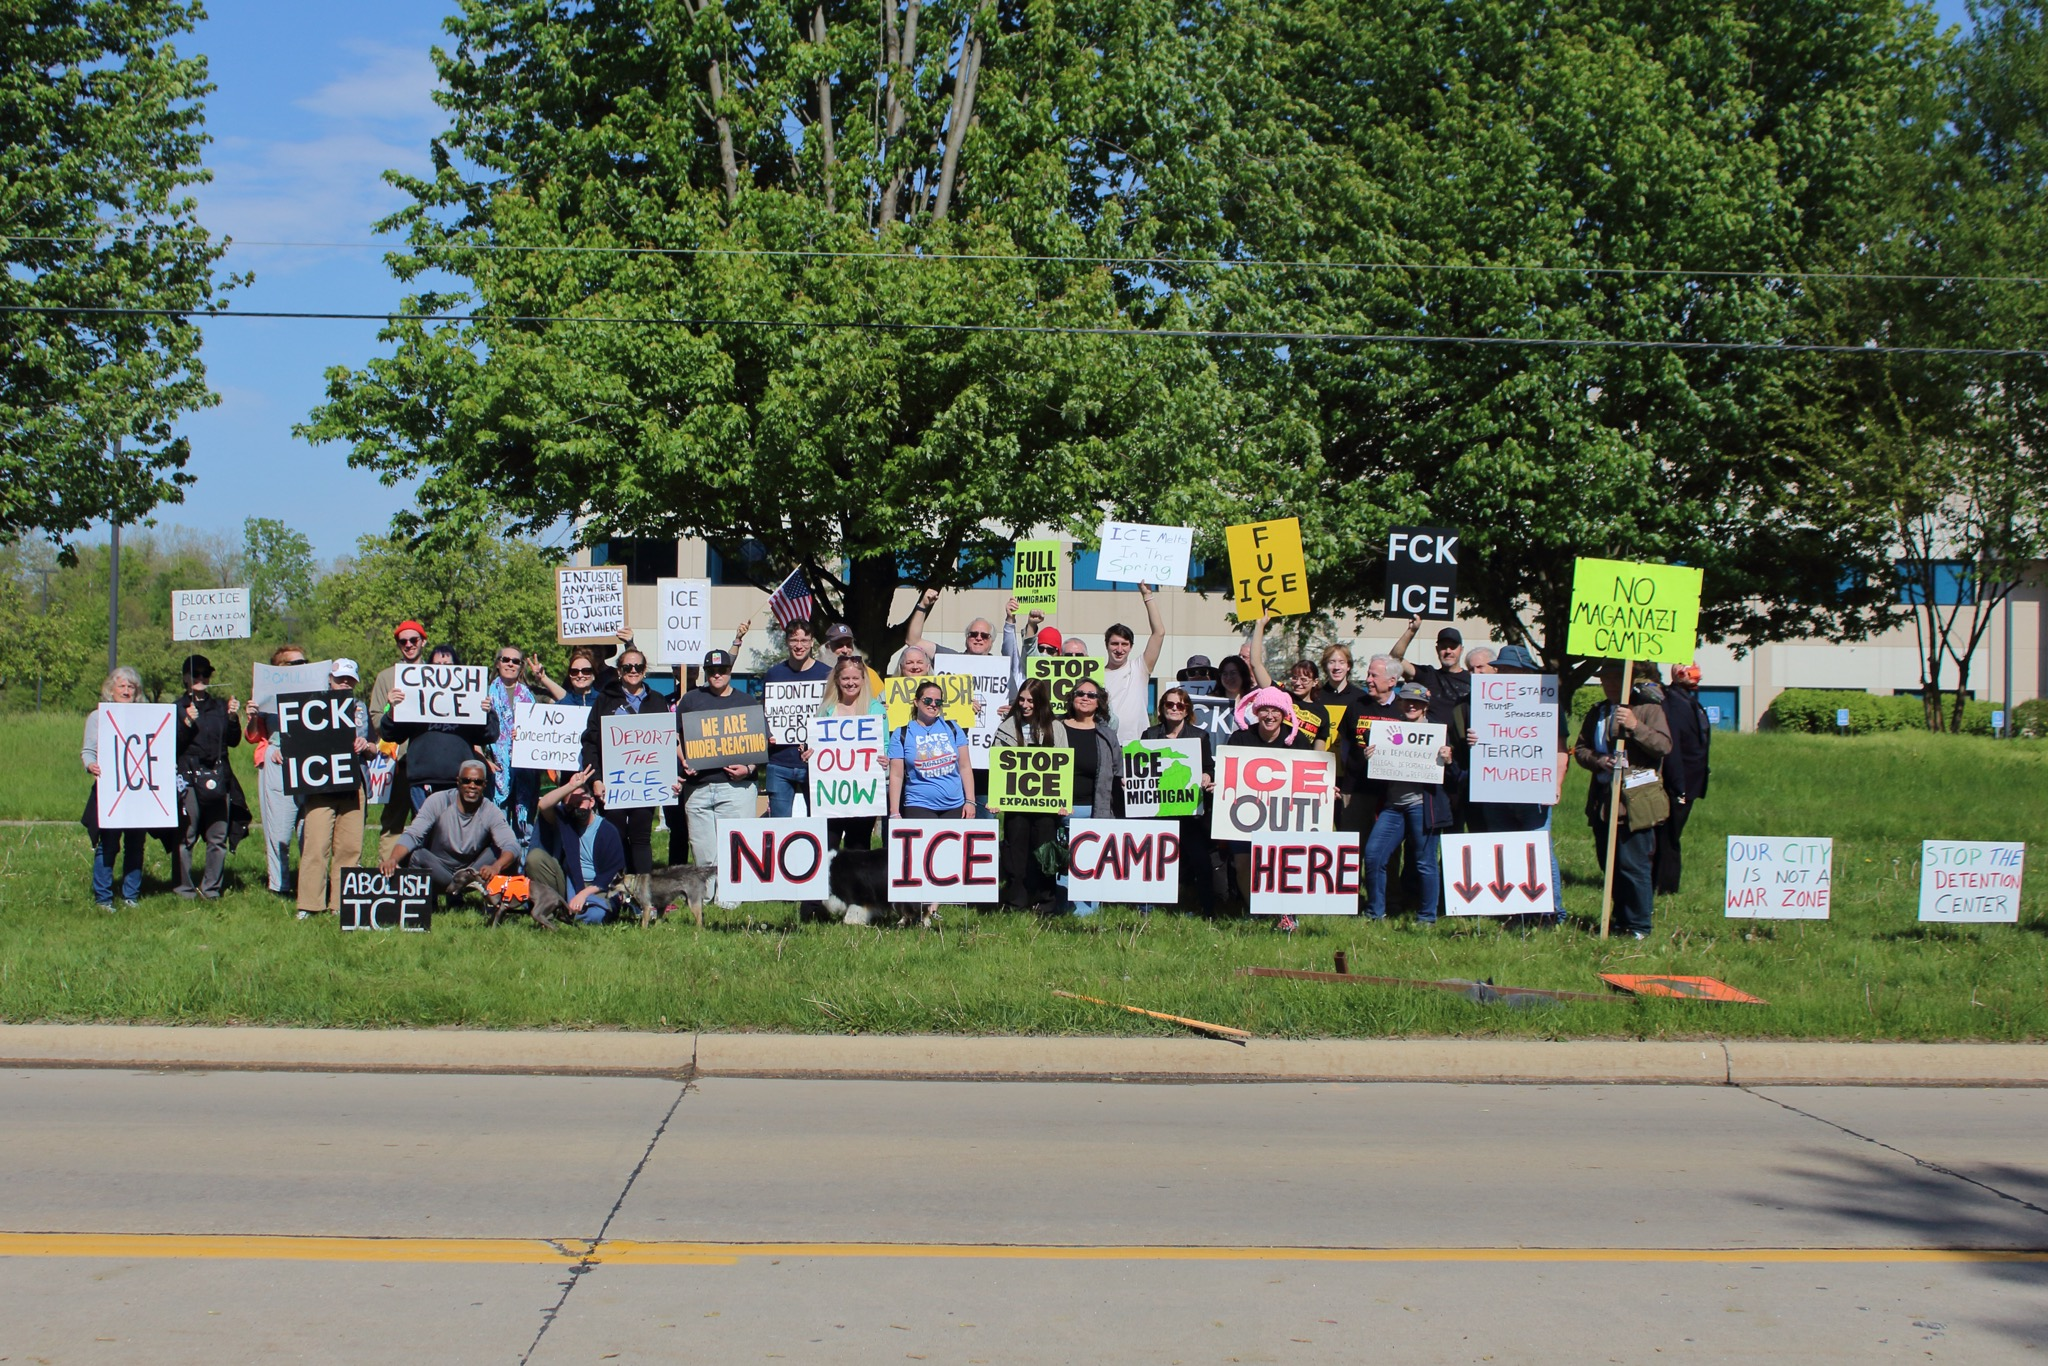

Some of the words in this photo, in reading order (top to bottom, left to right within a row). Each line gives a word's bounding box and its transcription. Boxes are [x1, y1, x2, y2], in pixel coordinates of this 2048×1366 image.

[1110, 527, 1150, 542] ICE
[1157, 533, 1188, 545] Melts
[1120, 546, 1139, 559] In
[1147, 547, 1174, 562] The
[1388, 533, 1458, 565] FCK
[1017, 551, 1056, 572] FULL
[1108, 559, 1172, 581] Spring
[562, 571, 623, 583] INJUSTICE
[1016, 573, 1056, 588] RIGHTS
[563, 583, 618, 595] ANYWHERE
[1239, 572, 1298, 603] ICE
[1614, 576, 1656, 605] NO
[181, 593, 216, 606] BLOCK
[219, 592, 240, 604] ICE
[562, 596, 575, 605] IS
[578, 596, 586, 605] A
[587, 593, 621, 604] THREAT
[671, 591, 698, 606] ICE
[1390, 584, 1450, 615] ICE
[179, 611, 246, 622] DETENTION
[562, 607, 579, 619] TO
[582, 606, 622, 619] JUSTICE
[667, 616, 701, 629] OUT
[1574, 602, 1678, 632] MAGANAZI
[189, 624, 235, 638] CAMP
[667, 640, 701, 651] NOW
[1595, 628, 1663, 656] CAMPS
[1035, 660, 1099, 677] STOP
[401, 666, 480, 693] CRUSH
[765, 685, 774, 699] I
[418, 691, 470, 718] ICE
[765, 703, 820, 716] UNACCOUNT
[278, 697, 356, 734] FCK
[542, 710, 564, 726] NO
[701, 717, 720, 738] WE
[723, 713, 748, 735] ARE
[1191, 704, 1233, 734] CK
[515, 725, 581, 744] Concentrati
[610, 726, 675, 747] DEPORT
[817, 718, 878, 742] ICE
[916, 733, 949, 745] CATS
[1408, 733, 1434, 745] OFF
[1488, 723, 1538, 739] THUGS
[531, 748, 577, 764] Camps
[686, 732, 766, 760] UNDER-REACTING
[1390, 749, 1433, 759] DEMOCRACY
[1478, 743, 1543, 759] TERROR
[114, 733, 160, 793] ICE
[622, 751, 659, 765] THE
[817, 748, 878, 772] OUT
[921, 755, 953, 768] AGAINST
[999, 750, 1069, 771] STOP
[1125, 752, 1162, 777] ICE
[288, 752, 354, 789] ICE
[609, 770, 662, 785] ICE
[920, 765, 954, 779] TRUMP
[1223, 756, 1329, 802] ICE
[1483, 767, 1552, 783] MURDER
[817, 778, 877, 806] NOW
[1006, 773, 1060, 796] ICE
[1126, 779, 1145, 789] OUT
[1147, 778, 1160, 789] OF
[607, 786, 669, 804] HOLES
[999, 797, 1067, 808] EXPANSION
[1126, 788, 1195, 805] MICHIGAN
[1229, 795, 1320, 832] OUT!
[729, 830, 823, 884] NO
[892, 828, 997, 887] ICE
[1069, 830, 1180, 883] CAMP
[1730, 842, 1772, 862] OUR
[1782, 844, 1832, 864] CITY
[1925, 846, 1983, 867] STOP
[1990, 847, 2024, 866] THE
[1251, 845, 1360, 895] HERE
[1743, 867, 1761, 883] IS
[1776, 869, 1810, 884] NOT
[1816, 872, 1830, 886] A
[1935, 870, 2021, 890] DETENTION
[343, 872, 431, 897] ABOLISH
[1728, 887, 1768, 909] WAR
[1782, 889, 1828, 908] ZONE
[1935, 894, 2008, 915] CENTER
[341, 899, 426, 932] ICE
